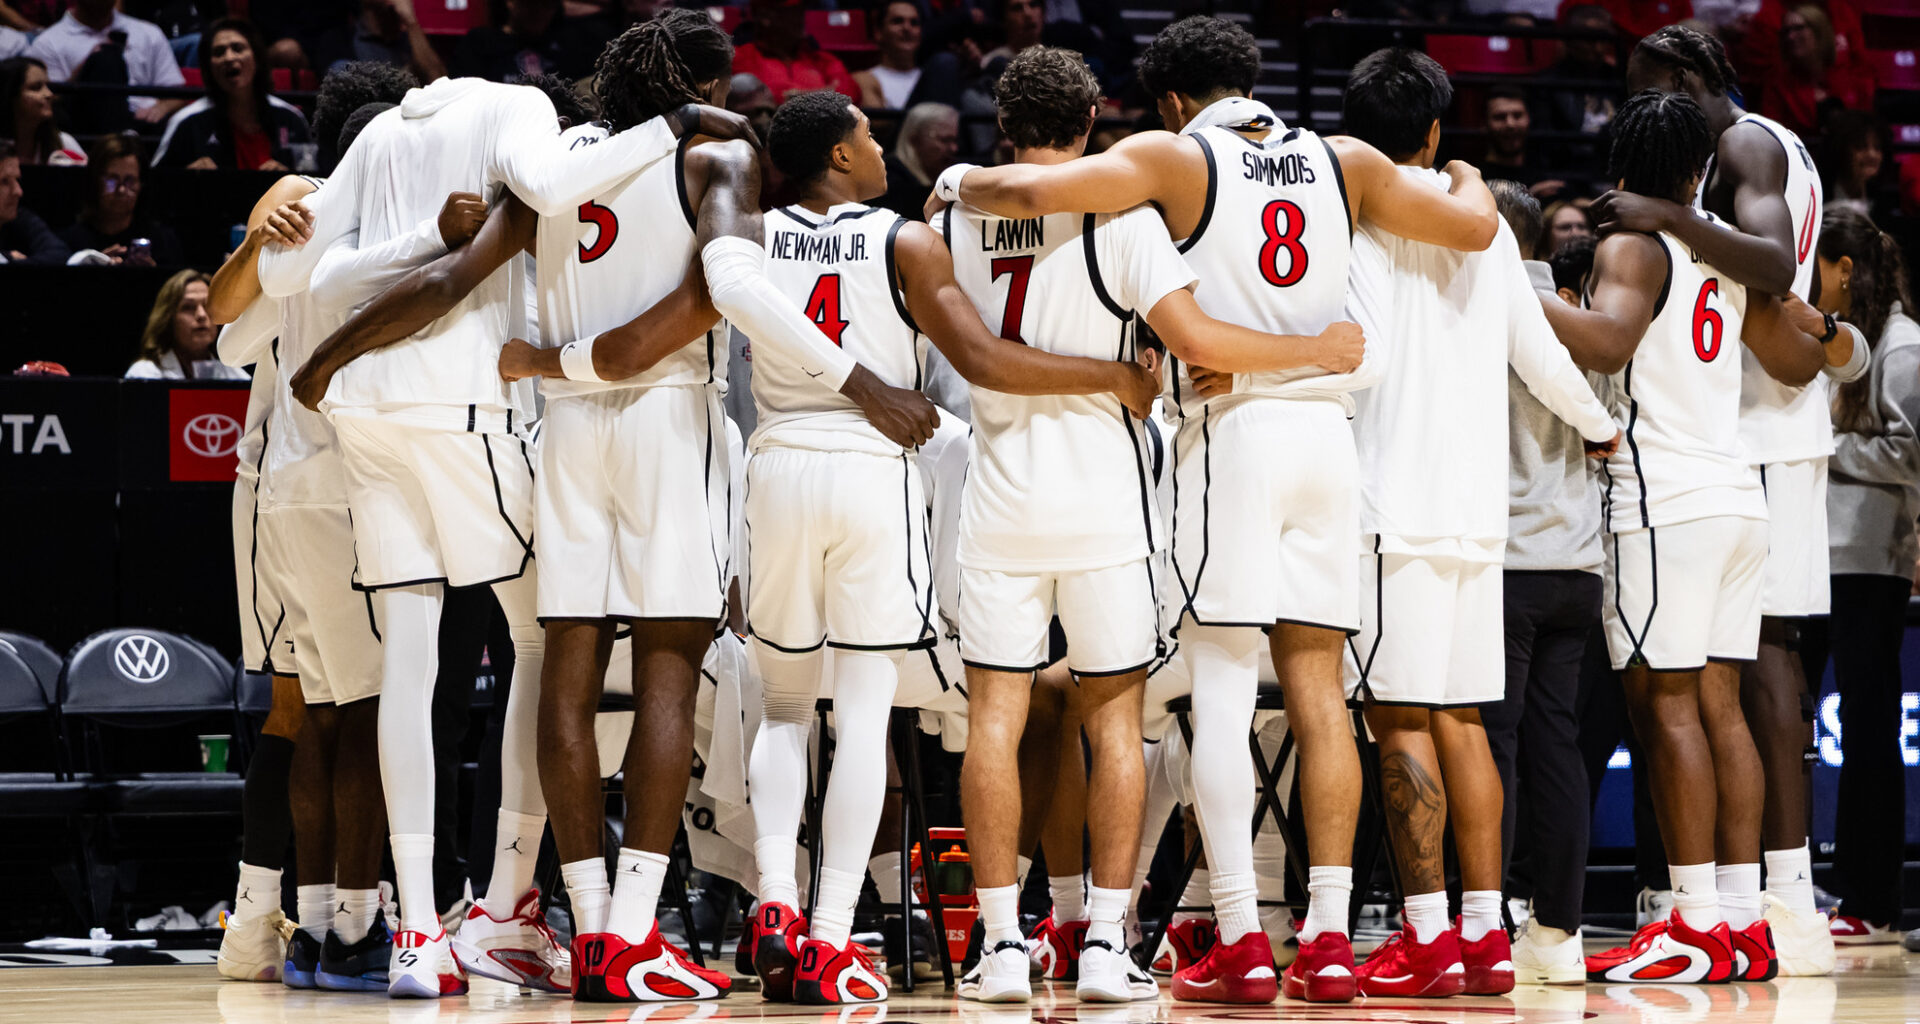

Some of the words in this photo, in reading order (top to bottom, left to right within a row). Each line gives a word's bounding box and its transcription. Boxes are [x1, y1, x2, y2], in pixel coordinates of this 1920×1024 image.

[771, 230, 841, 265] NEWMAN
[844, 233, 869, 261] JR.
[982, 215, 1044, 251] LAWIN
[1258, 199, 1309, 287] 8
[804, 273, 850, 349] 4
[990, 254, 1035, 345] 7
[1692, 277, 1723, 363] 6
[0, 414, 72, 454] TA
